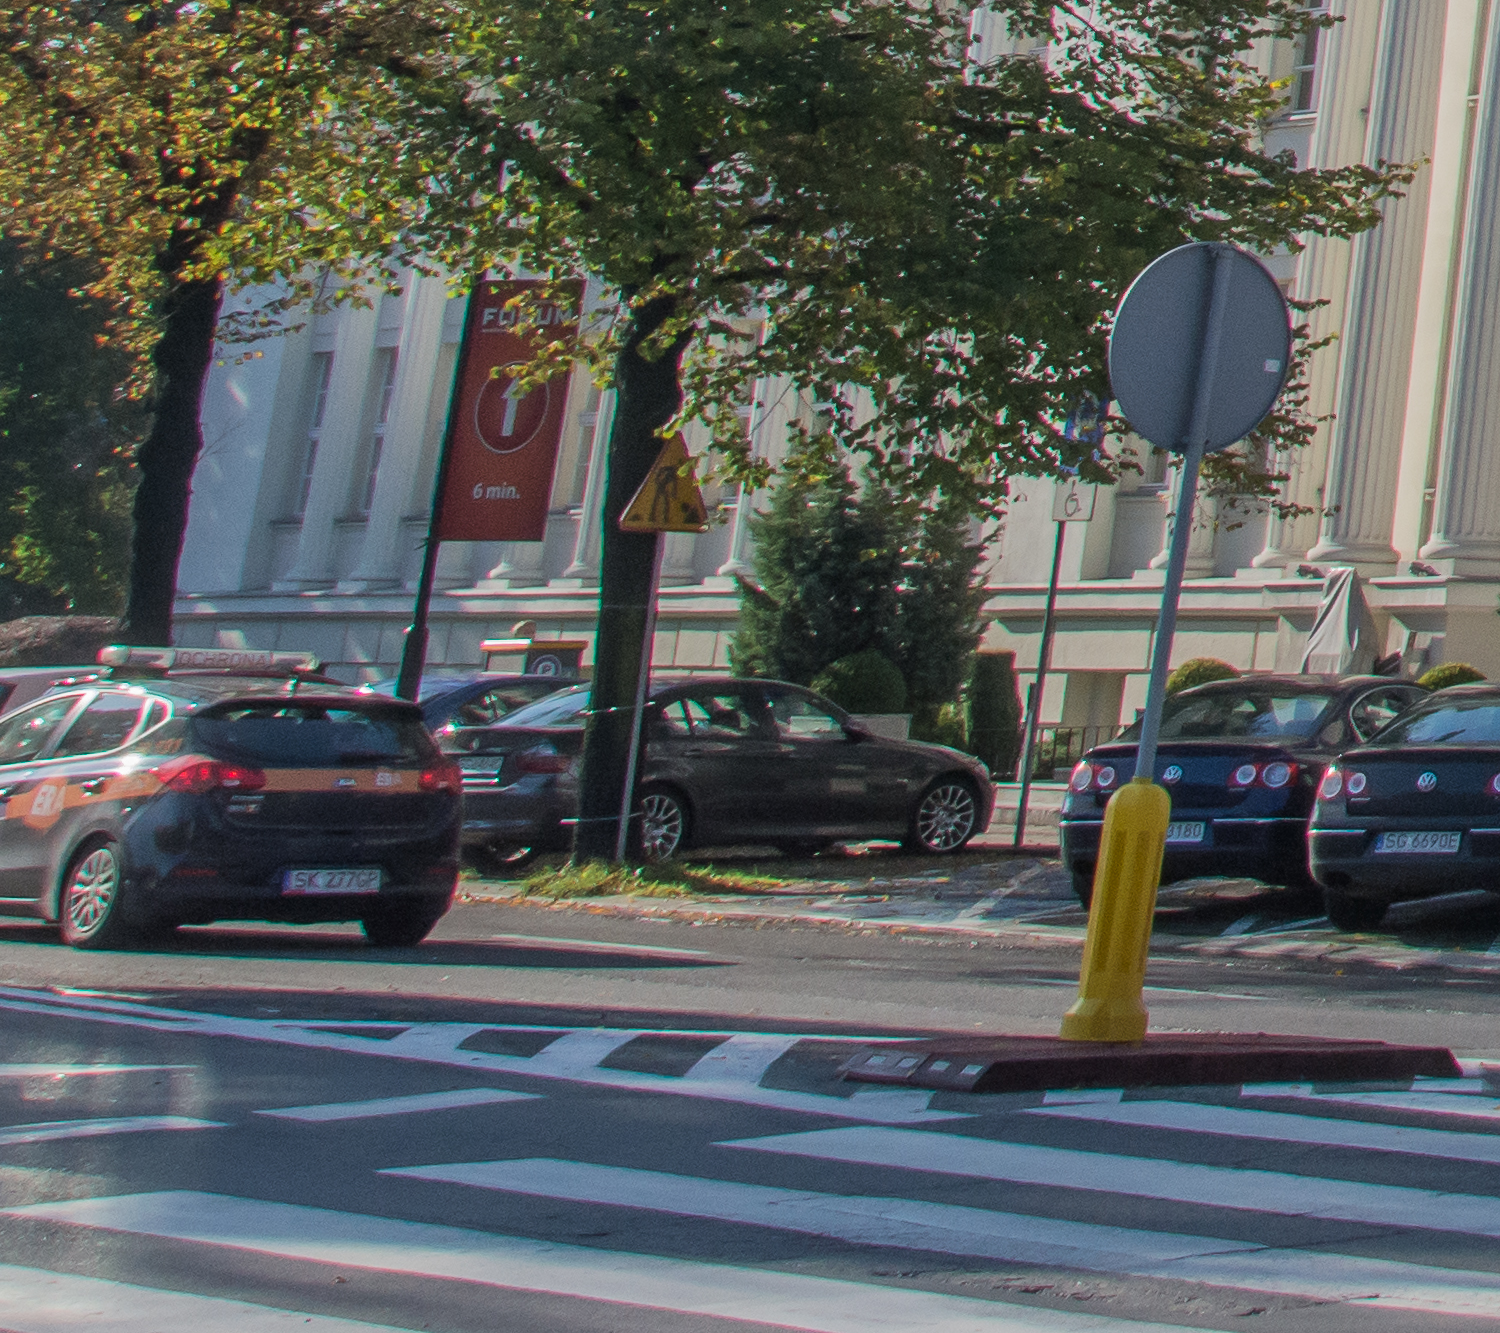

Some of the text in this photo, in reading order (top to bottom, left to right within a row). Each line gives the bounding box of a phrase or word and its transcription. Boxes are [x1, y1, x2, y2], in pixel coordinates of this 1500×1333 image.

[473, 482, 521, 500] 6 min.
[178, 651, 268, 667] OCHRONA
[1385, 832, 1407, 849] SG
[295, 870, 320, 888] SK
